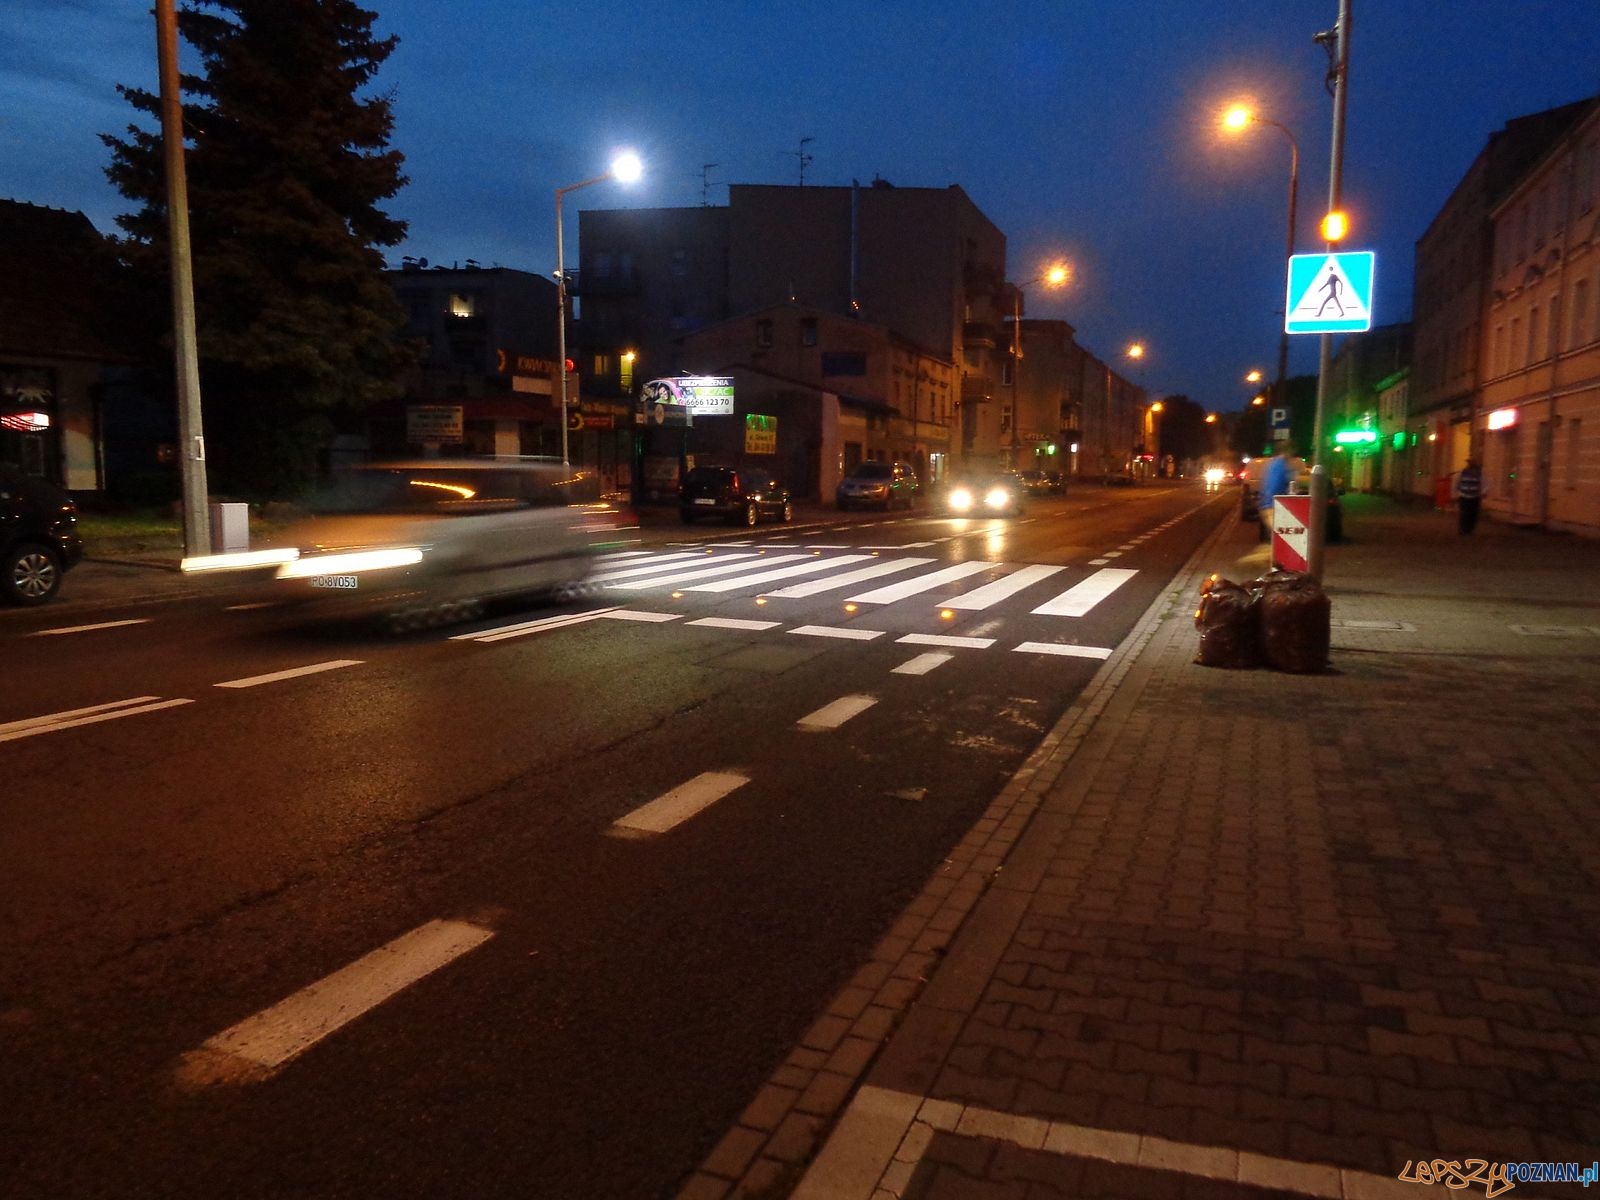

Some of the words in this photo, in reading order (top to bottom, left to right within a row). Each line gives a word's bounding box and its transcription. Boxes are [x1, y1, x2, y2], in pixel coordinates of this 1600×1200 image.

[678, 379, 729, 387] UBEZPIZENIA
[720, 398, 730, 406] 70
[1271, 408, 1286, 426] P
